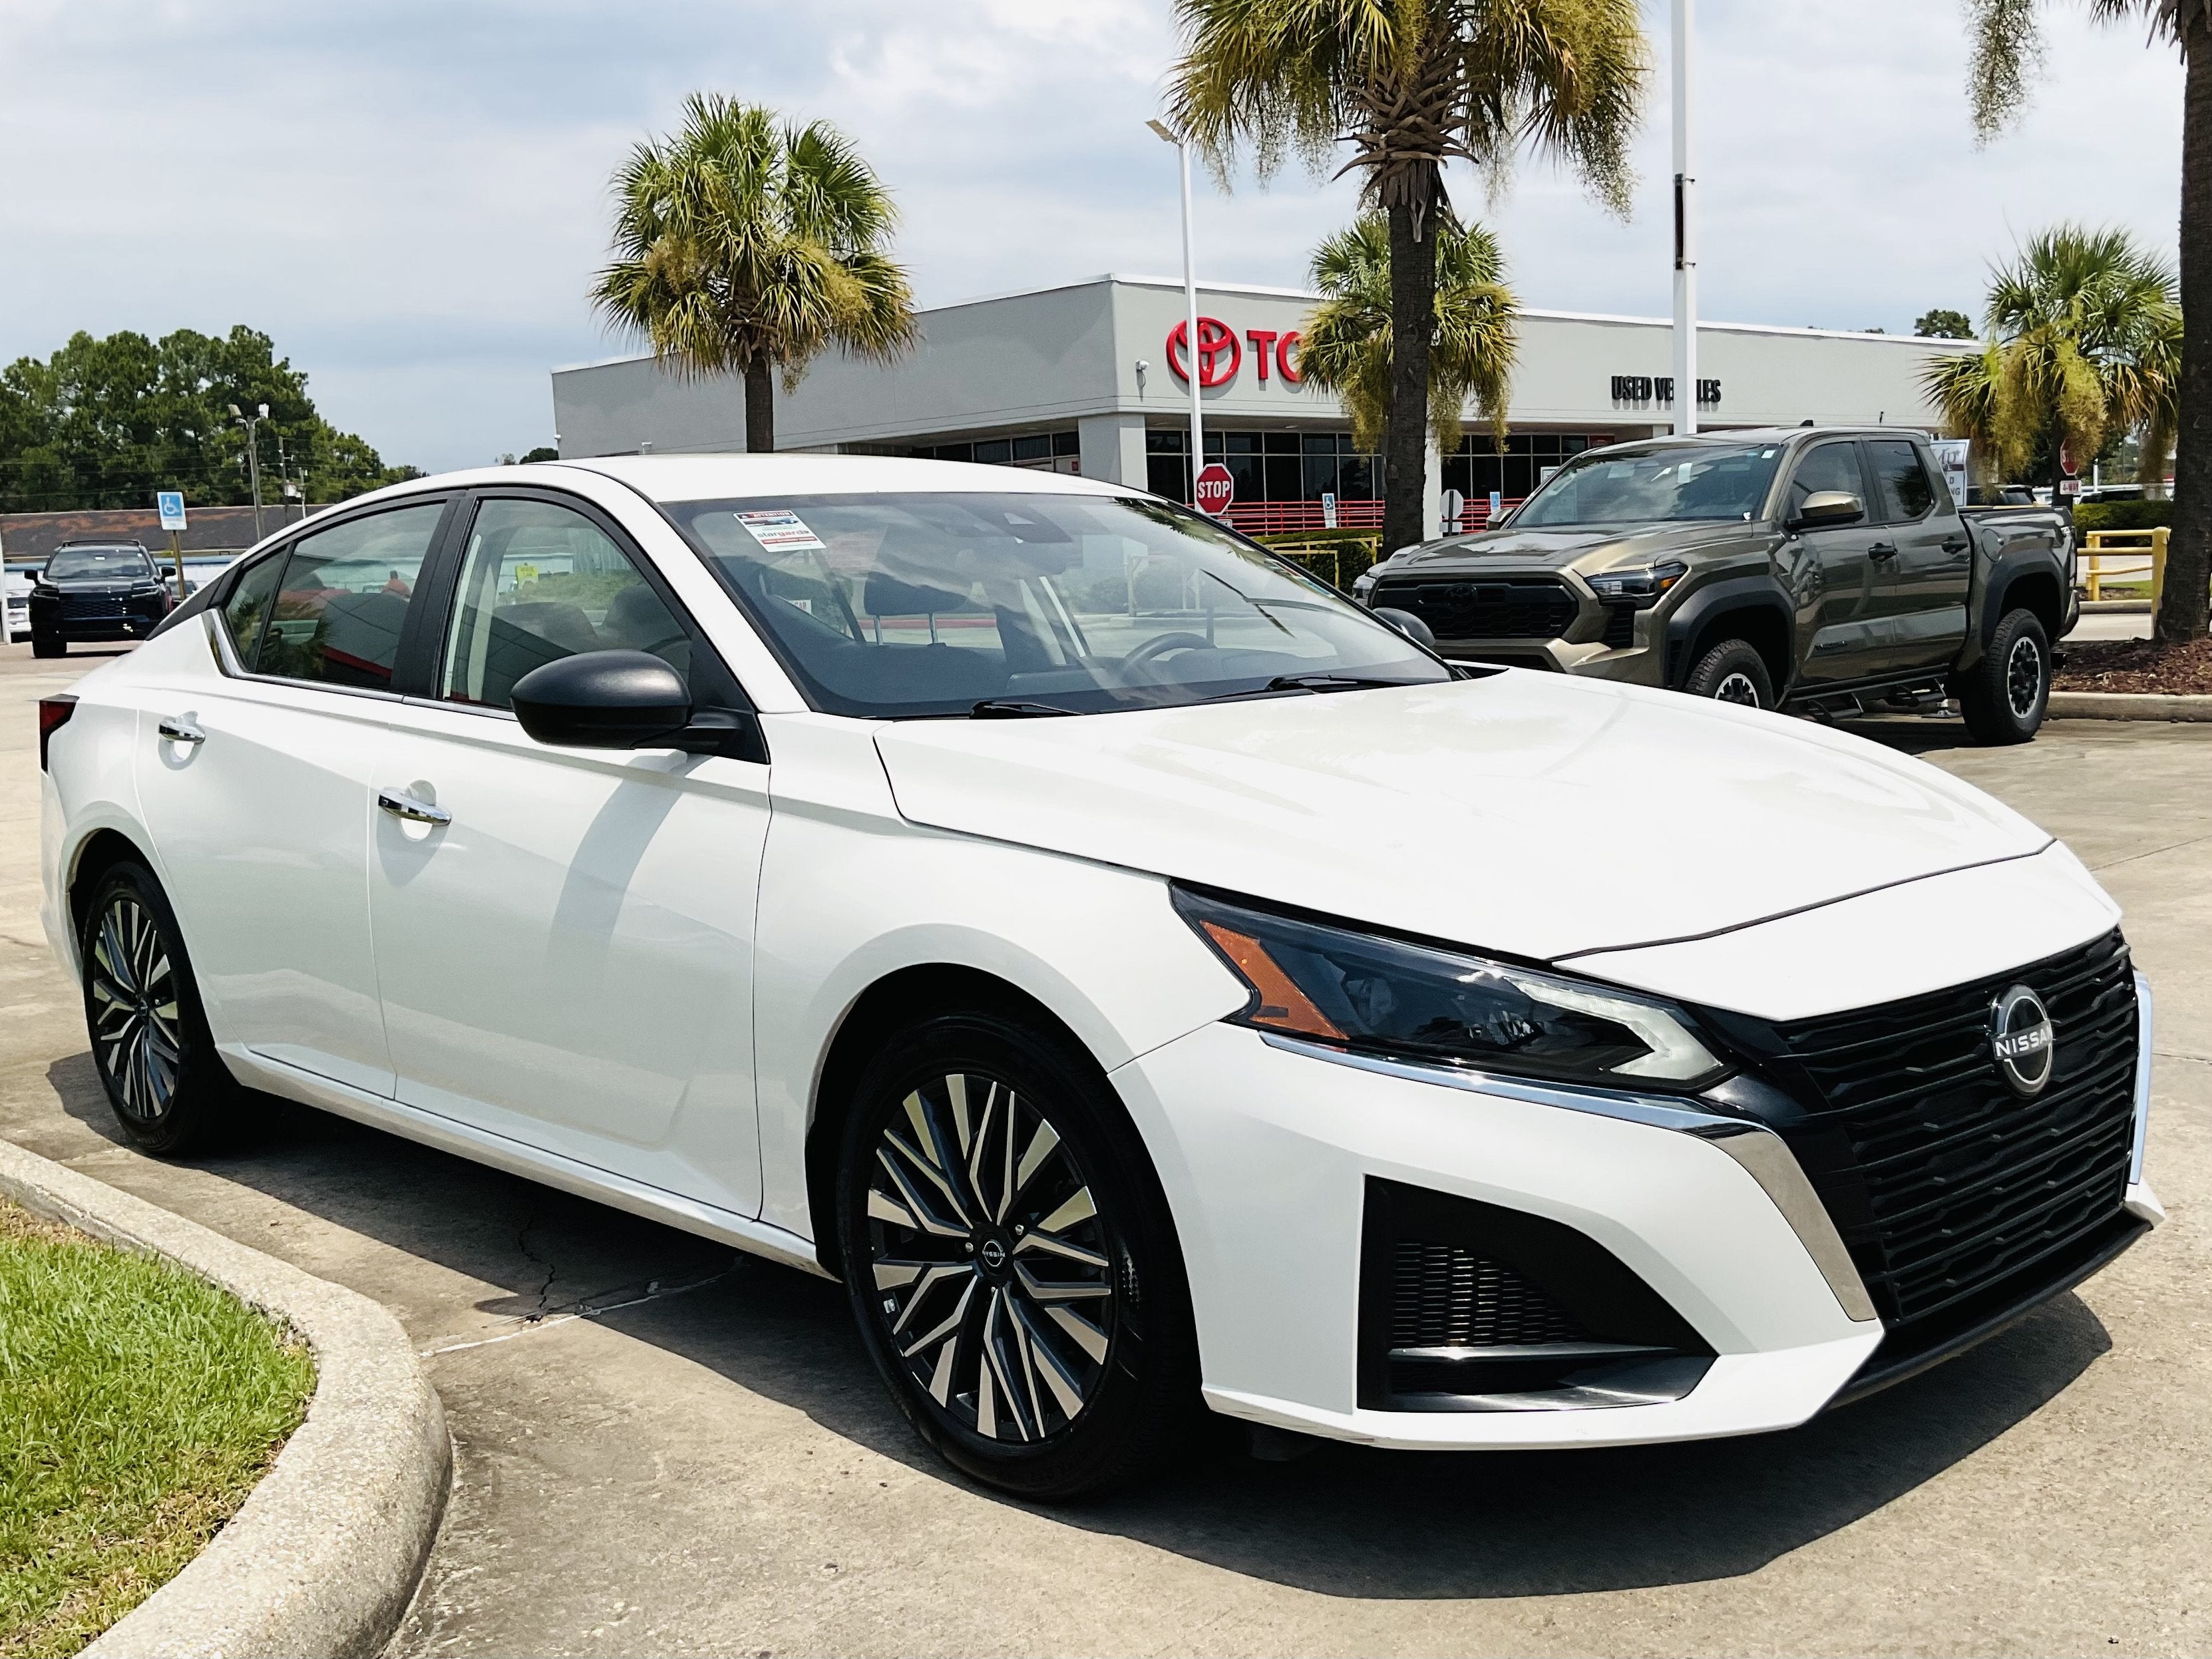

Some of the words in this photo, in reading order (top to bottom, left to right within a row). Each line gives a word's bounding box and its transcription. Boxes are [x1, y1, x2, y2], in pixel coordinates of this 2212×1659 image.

[1611, 376, 1652, 400] USED
[1654, 377, 1722, 403] VELES
[1198, 480, 1230, 499] STOP
[2062, 482, 2079, 491] 4-WAY
[1994, 1025, 2054, 1057] NISSAN
